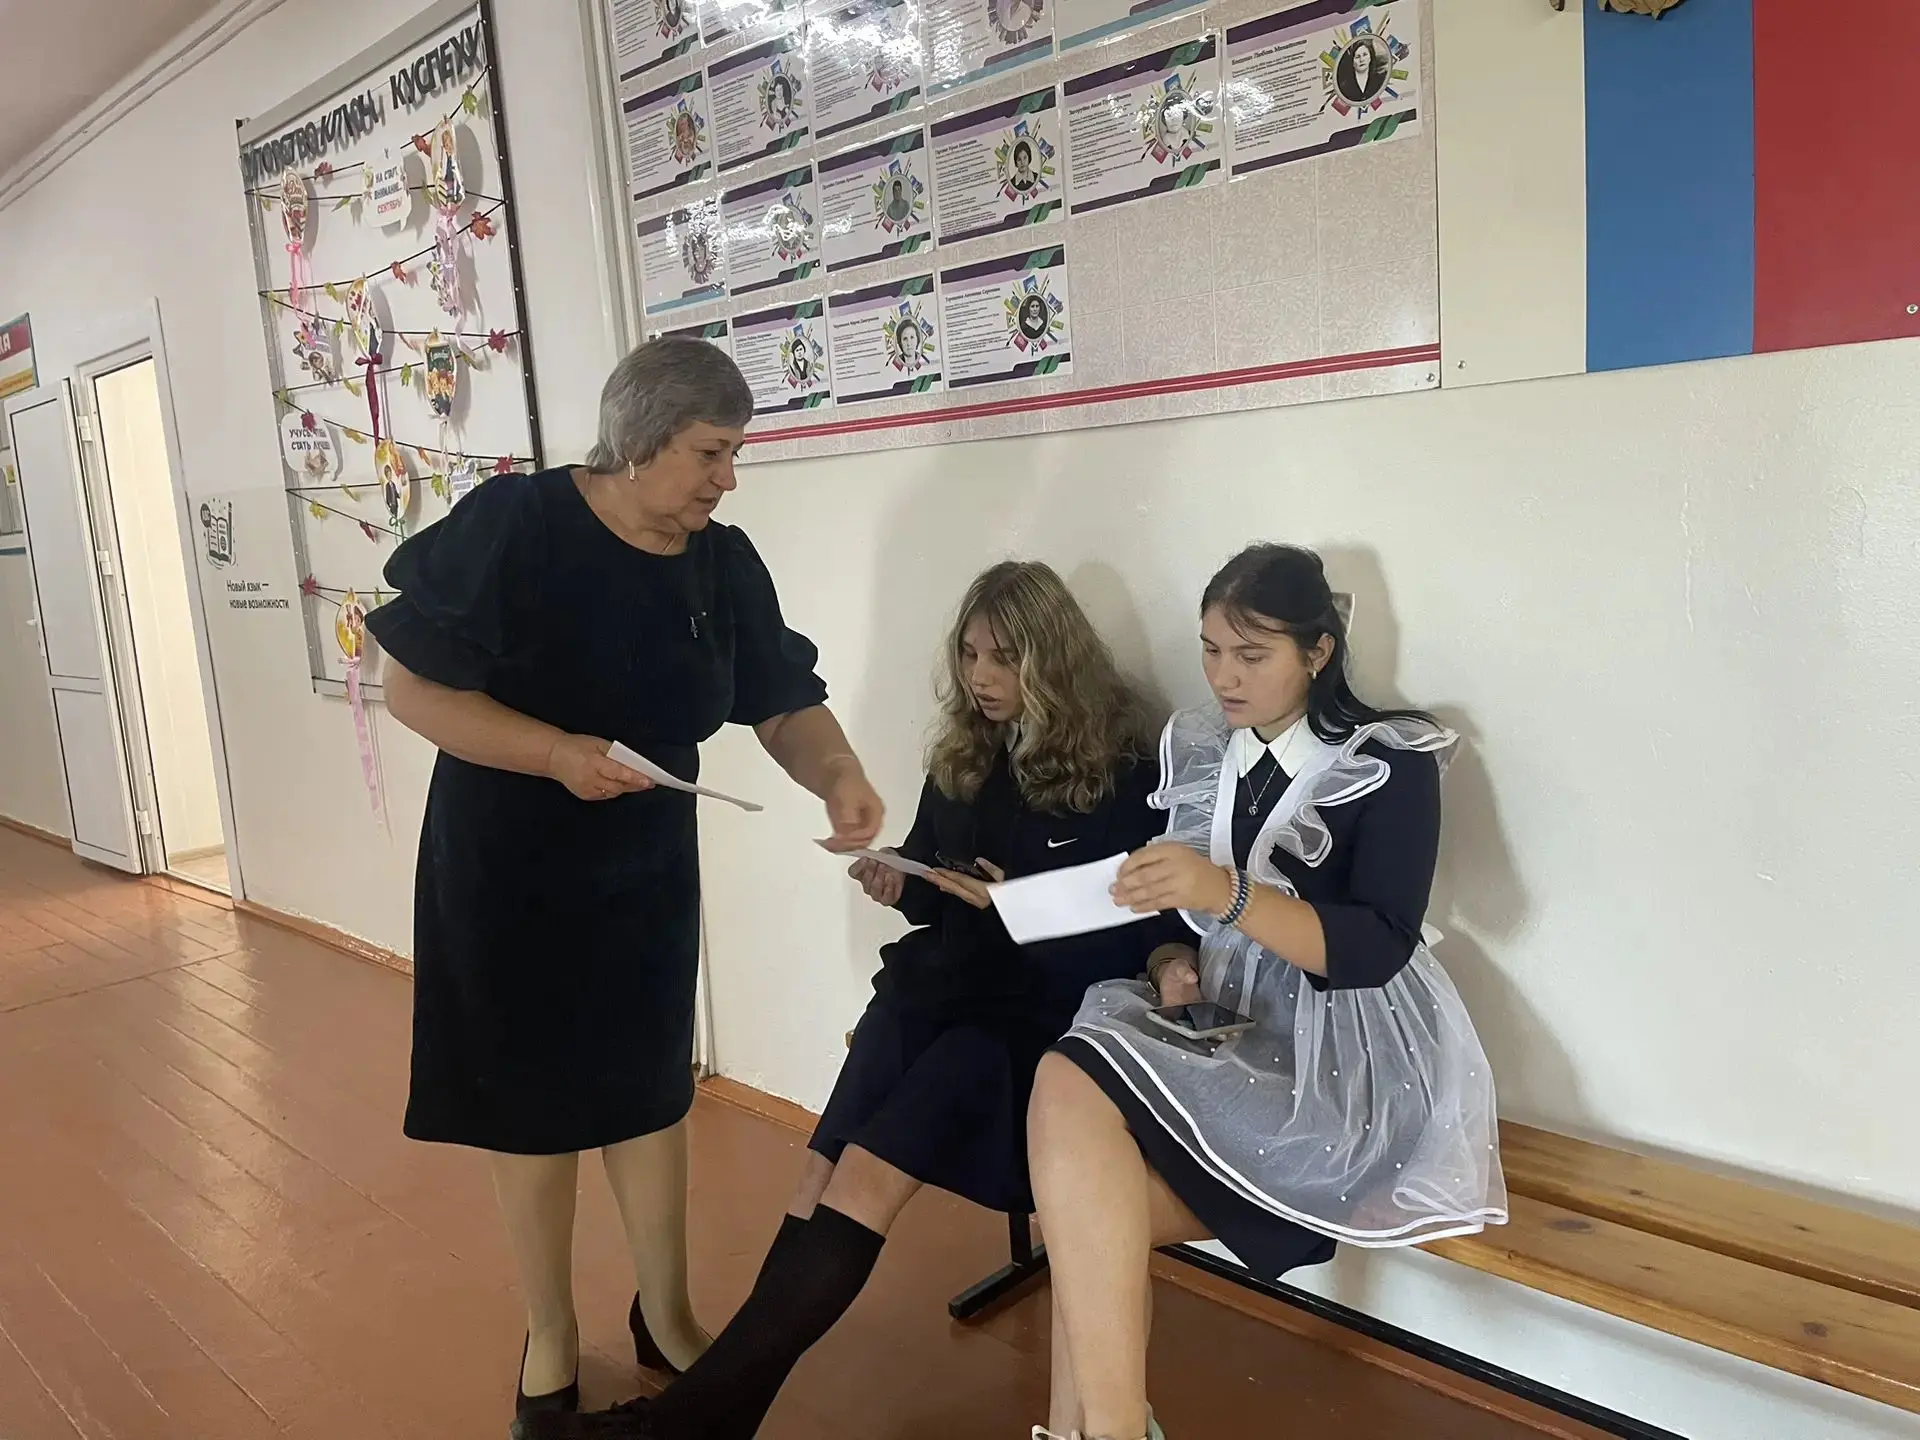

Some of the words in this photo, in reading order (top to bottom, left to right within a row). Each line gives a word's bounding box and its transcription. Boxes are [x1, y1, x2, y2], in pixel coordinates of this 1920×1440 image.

[226, 579, 246, 592] Новый
[246, 582, 262, 592] язык
[229, 599, 247, 609] новые
[248, 598, 290, 609] возможности
